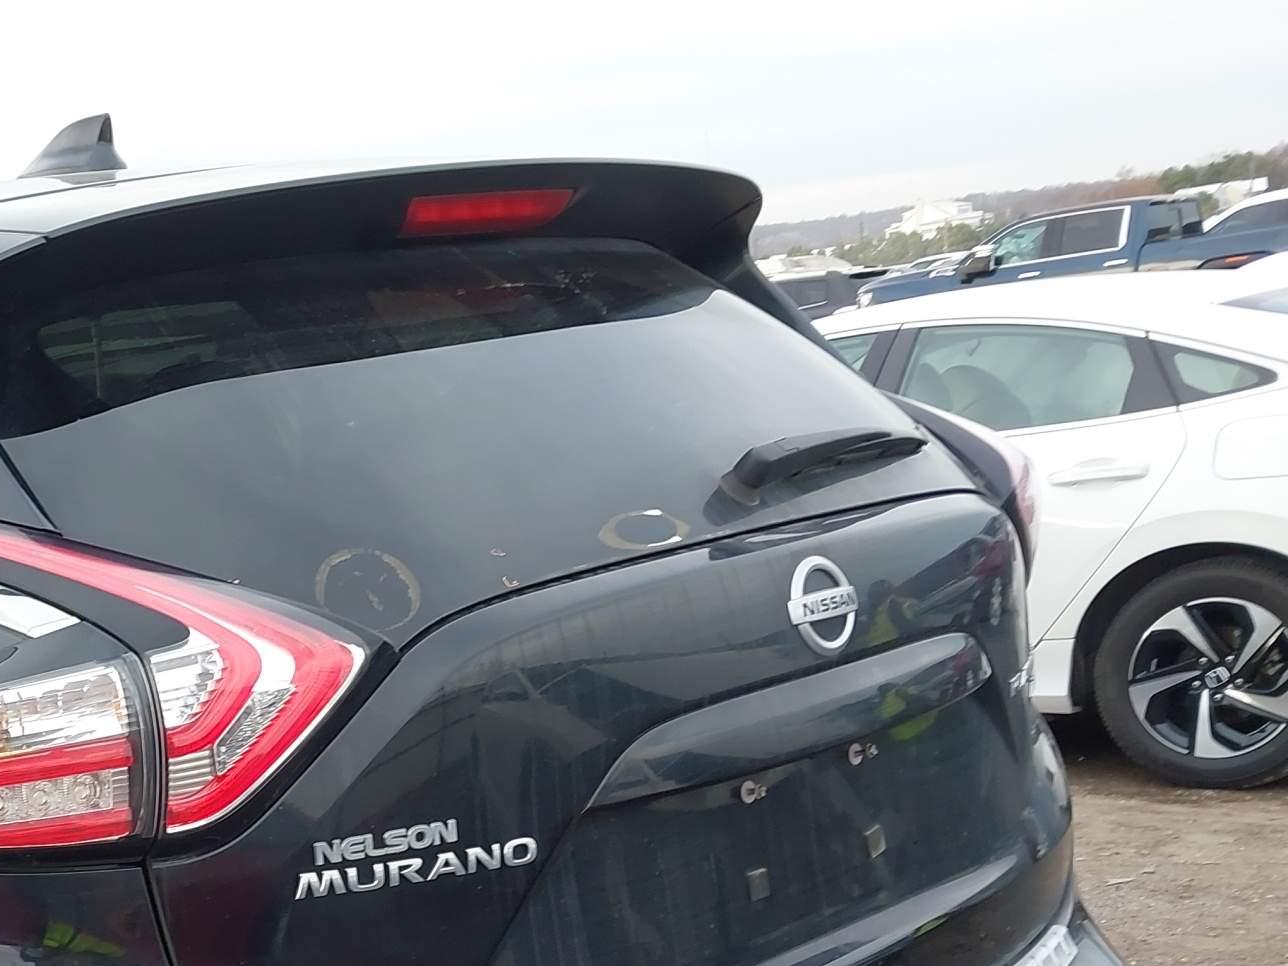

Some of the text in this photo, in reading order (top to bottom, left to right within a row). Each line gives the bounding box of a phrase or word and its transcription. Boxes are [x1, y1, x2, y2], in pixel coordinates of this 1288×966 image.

[802, 591, 857, 617] NISSAN
[312, 818, 459, 866] NELSON
[294, 836, 538, 900] MURANO
